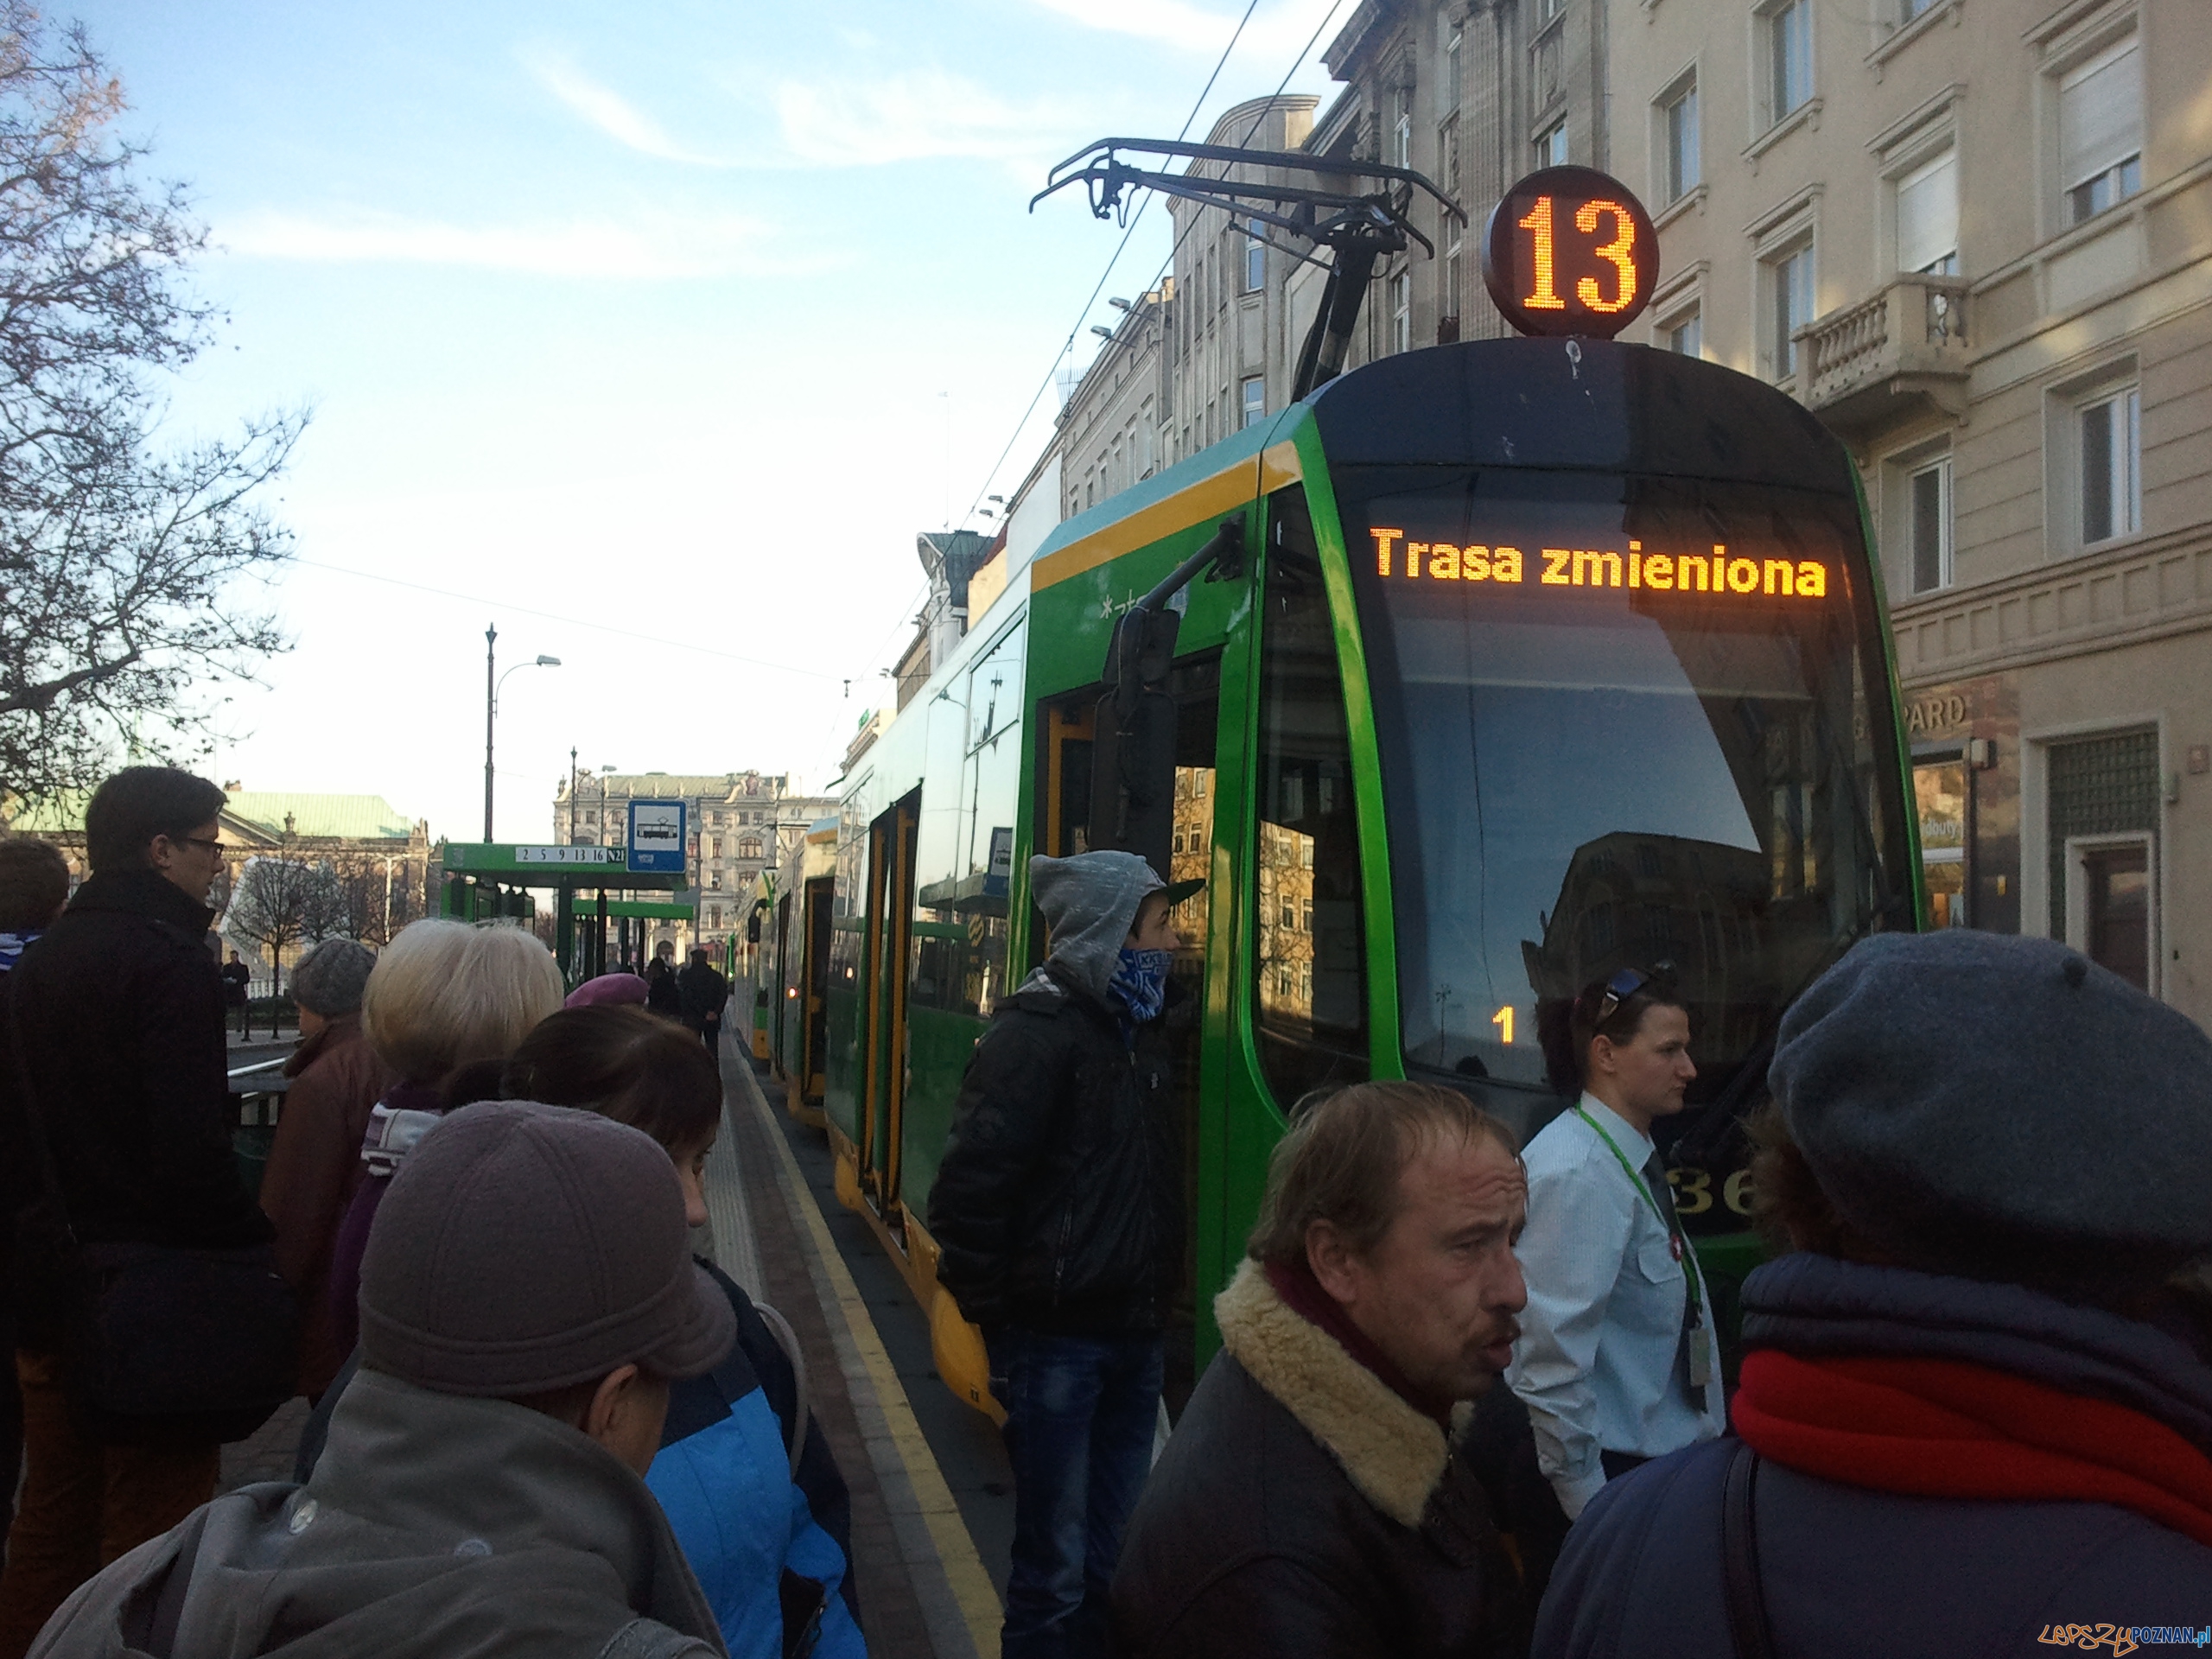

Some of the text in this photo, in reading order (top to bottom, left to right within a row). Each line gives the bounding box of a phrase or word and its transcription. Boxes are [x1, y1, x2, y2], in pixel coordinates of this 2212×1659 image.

[1518, 196, 1637, 313] 13
[1370, 527, 1827, 598] Trasa zmieniona
[523, 849, 529, 861] 2
[541, 849, 546, 861] 5
[559, 849, 565, 861] 9
[575, 849, 586, 861] 13
[594, 849, 604, 861] 16
[1492, 1006, 1514, 1044] 1
